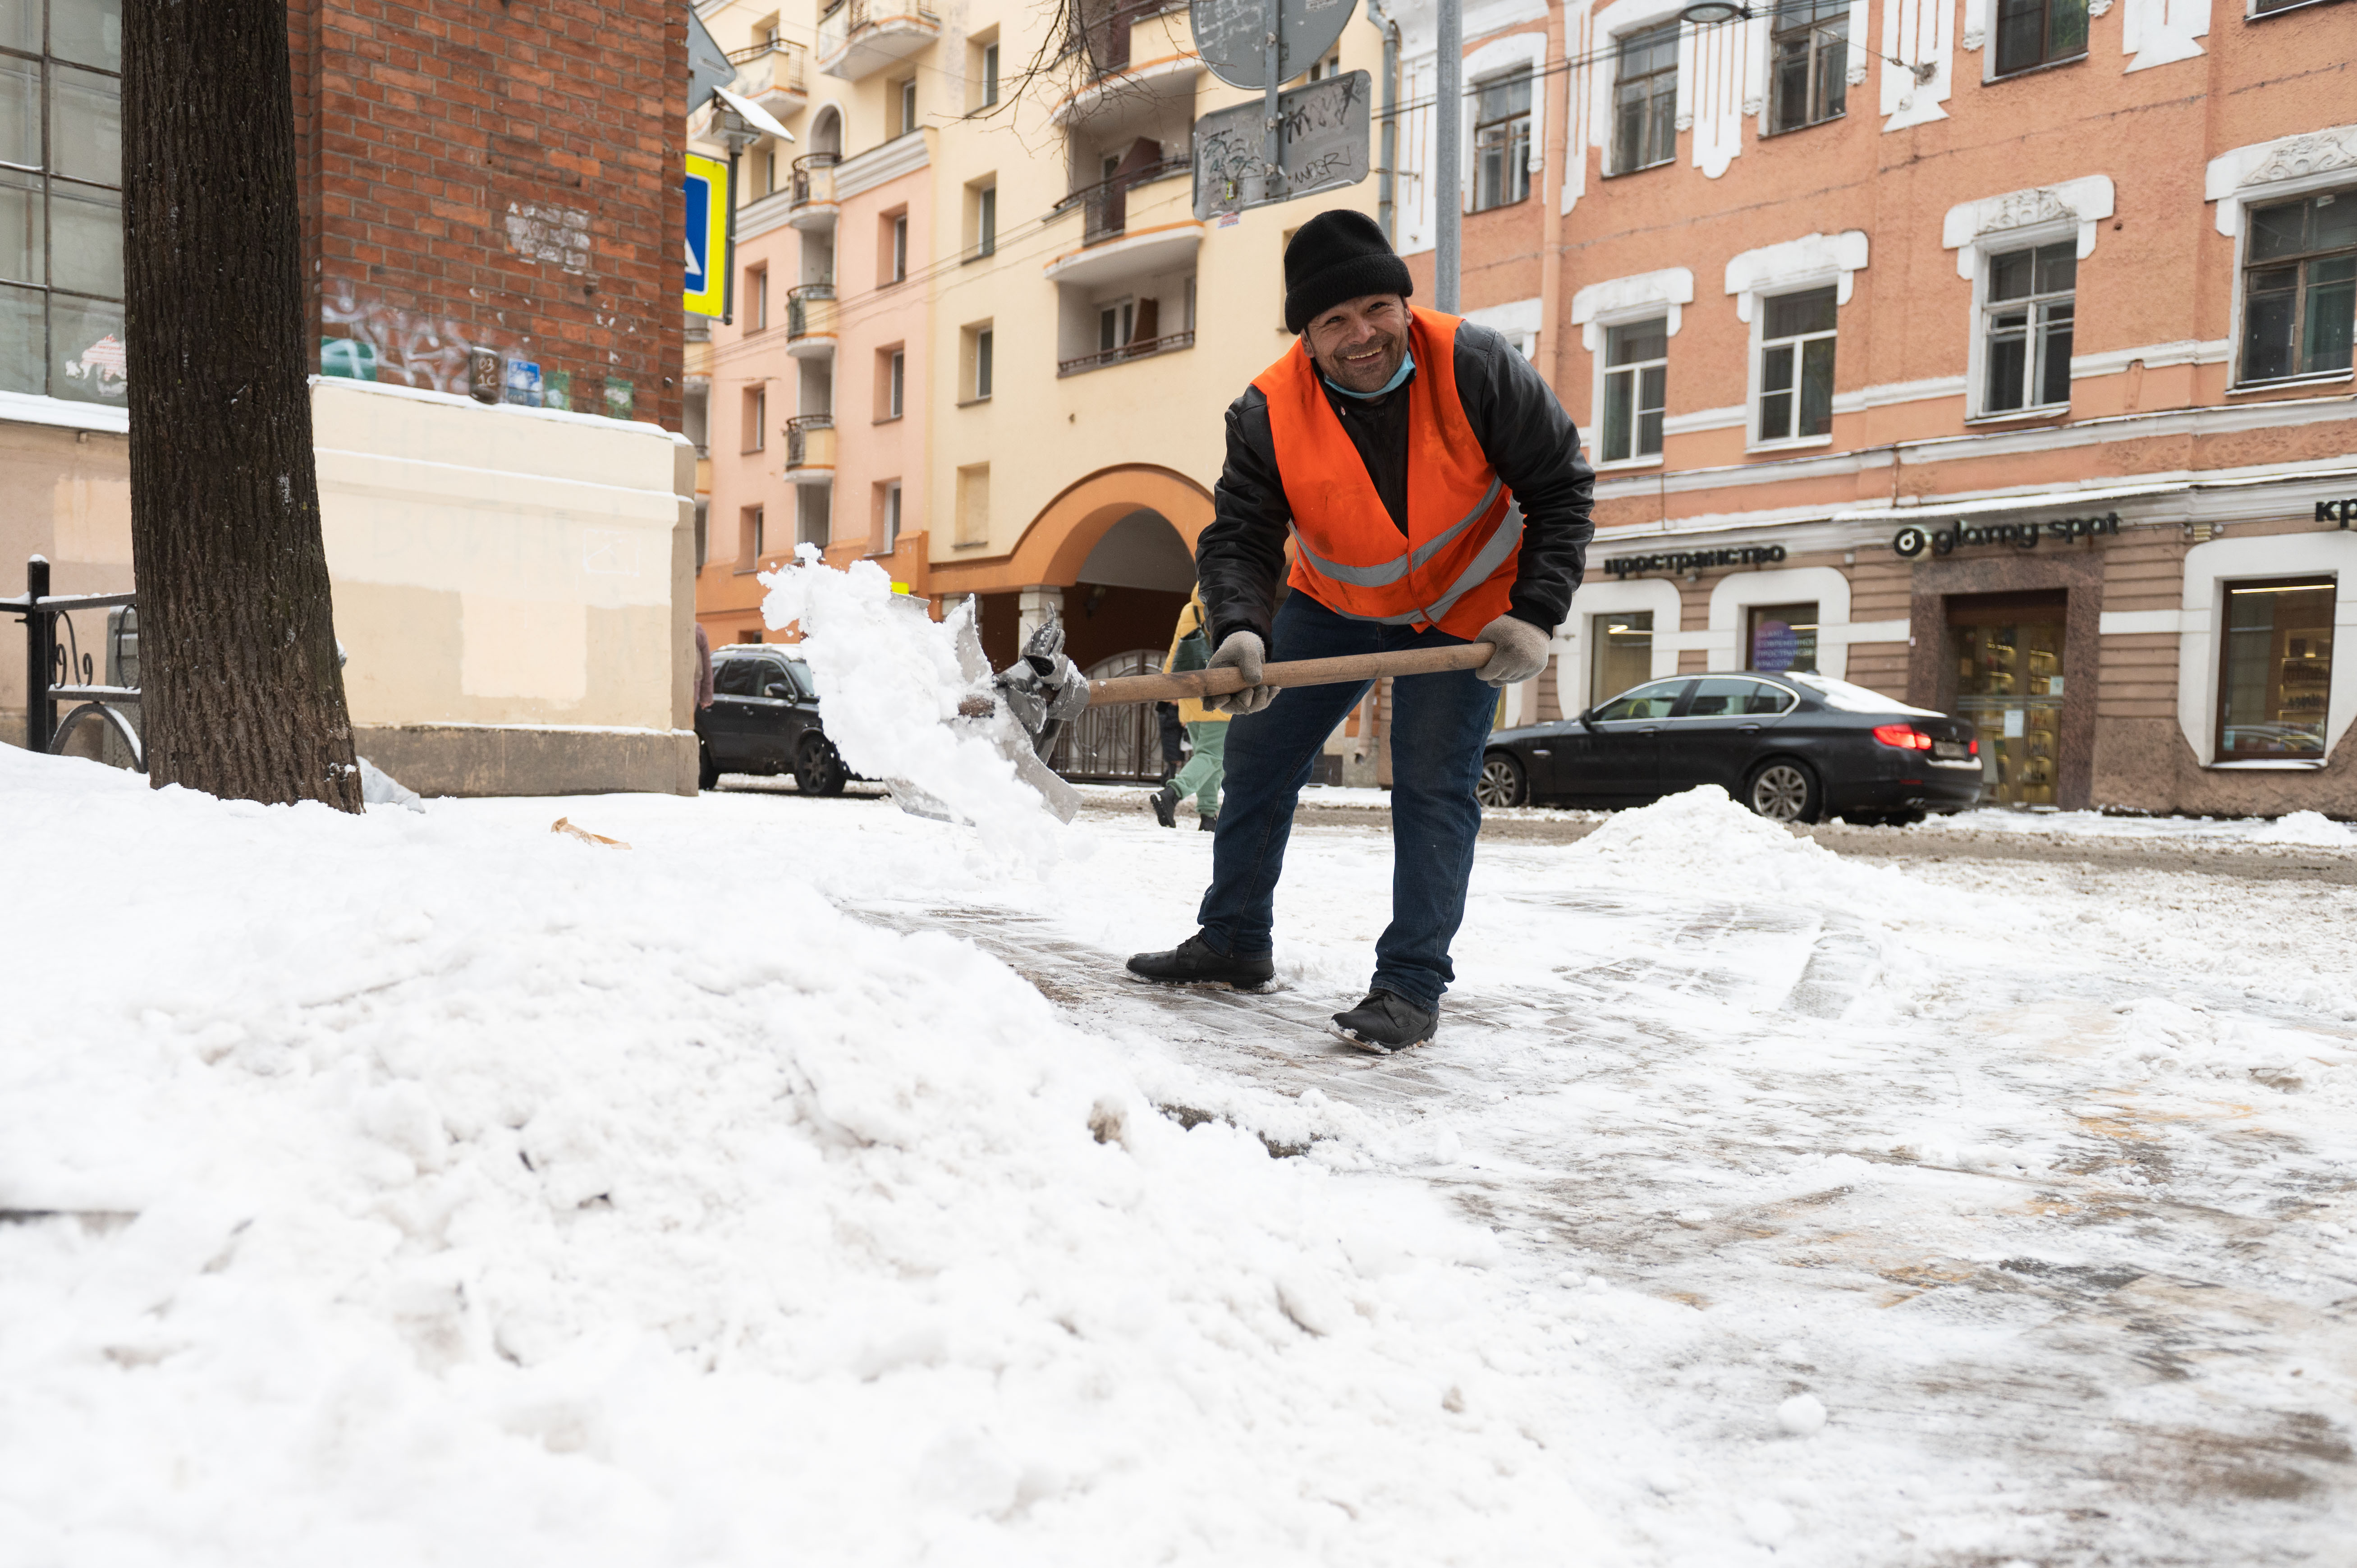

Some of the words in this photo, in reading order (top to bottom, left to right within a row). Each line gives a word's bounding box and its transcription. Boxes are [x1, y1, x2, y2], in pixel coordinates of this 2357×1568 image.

[1933, 520, 2039, 555] glamy
[2047, 512, 2119, 544] spot
[1604, 545, 1787, 579] пространство
